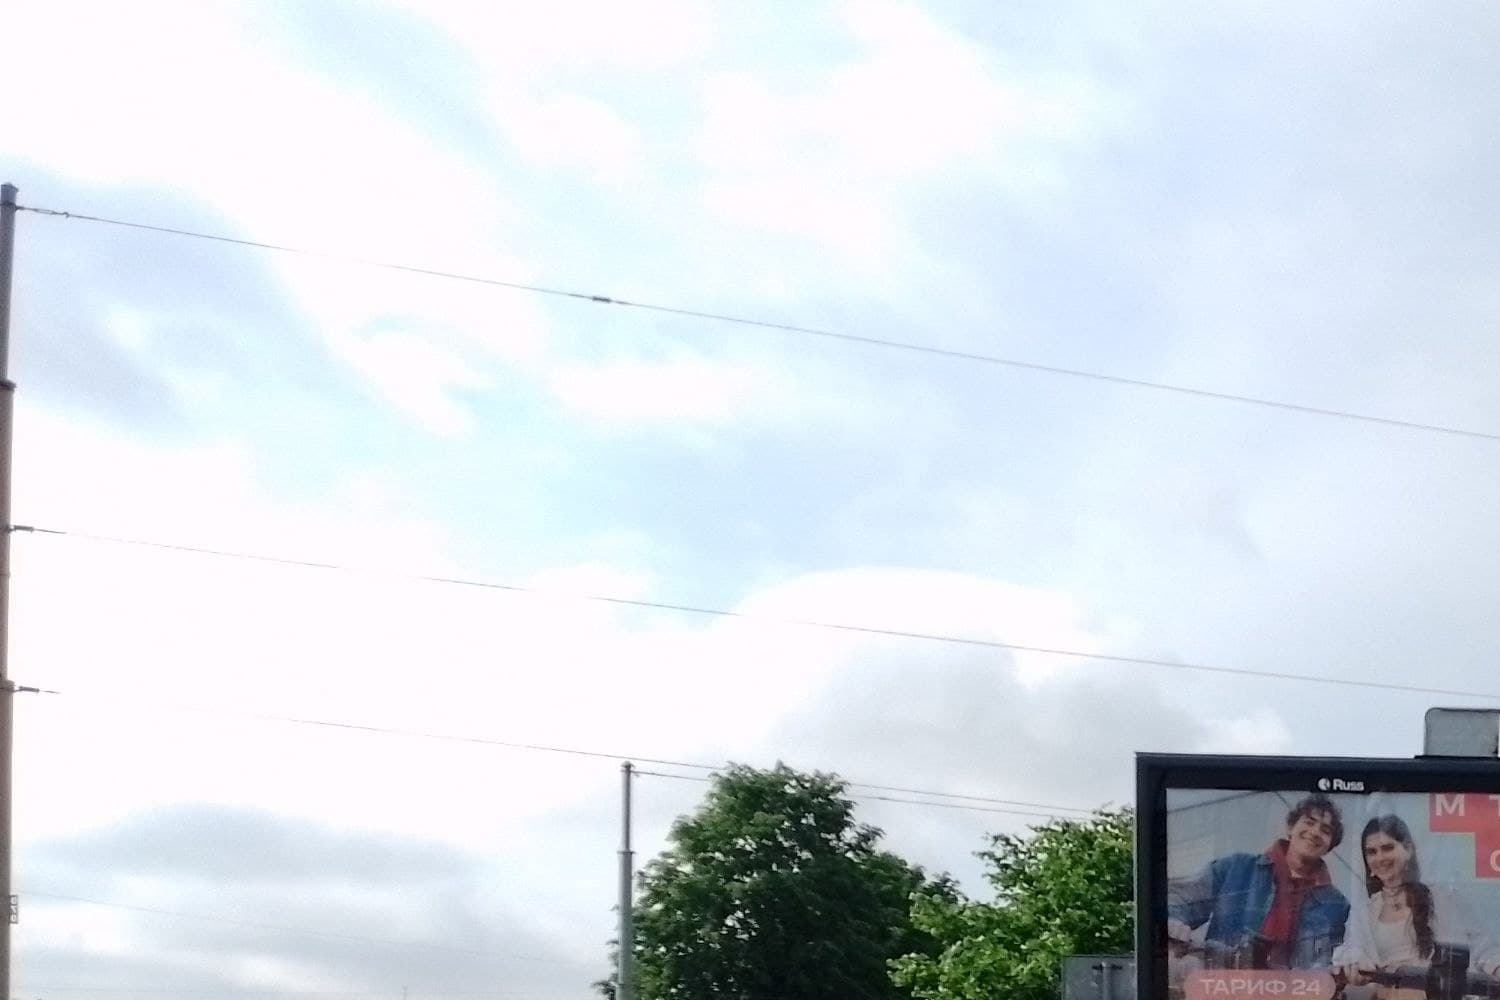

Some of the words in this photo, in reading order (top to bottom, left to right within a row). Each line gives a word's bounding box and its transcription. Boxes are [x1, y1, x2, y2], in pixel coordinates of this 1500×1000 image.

[1332, 778, 1365, 791] Russ
[1200, 978, 1287, 996] ТАРИФ
[1292, 978, 1321, 996] 24
